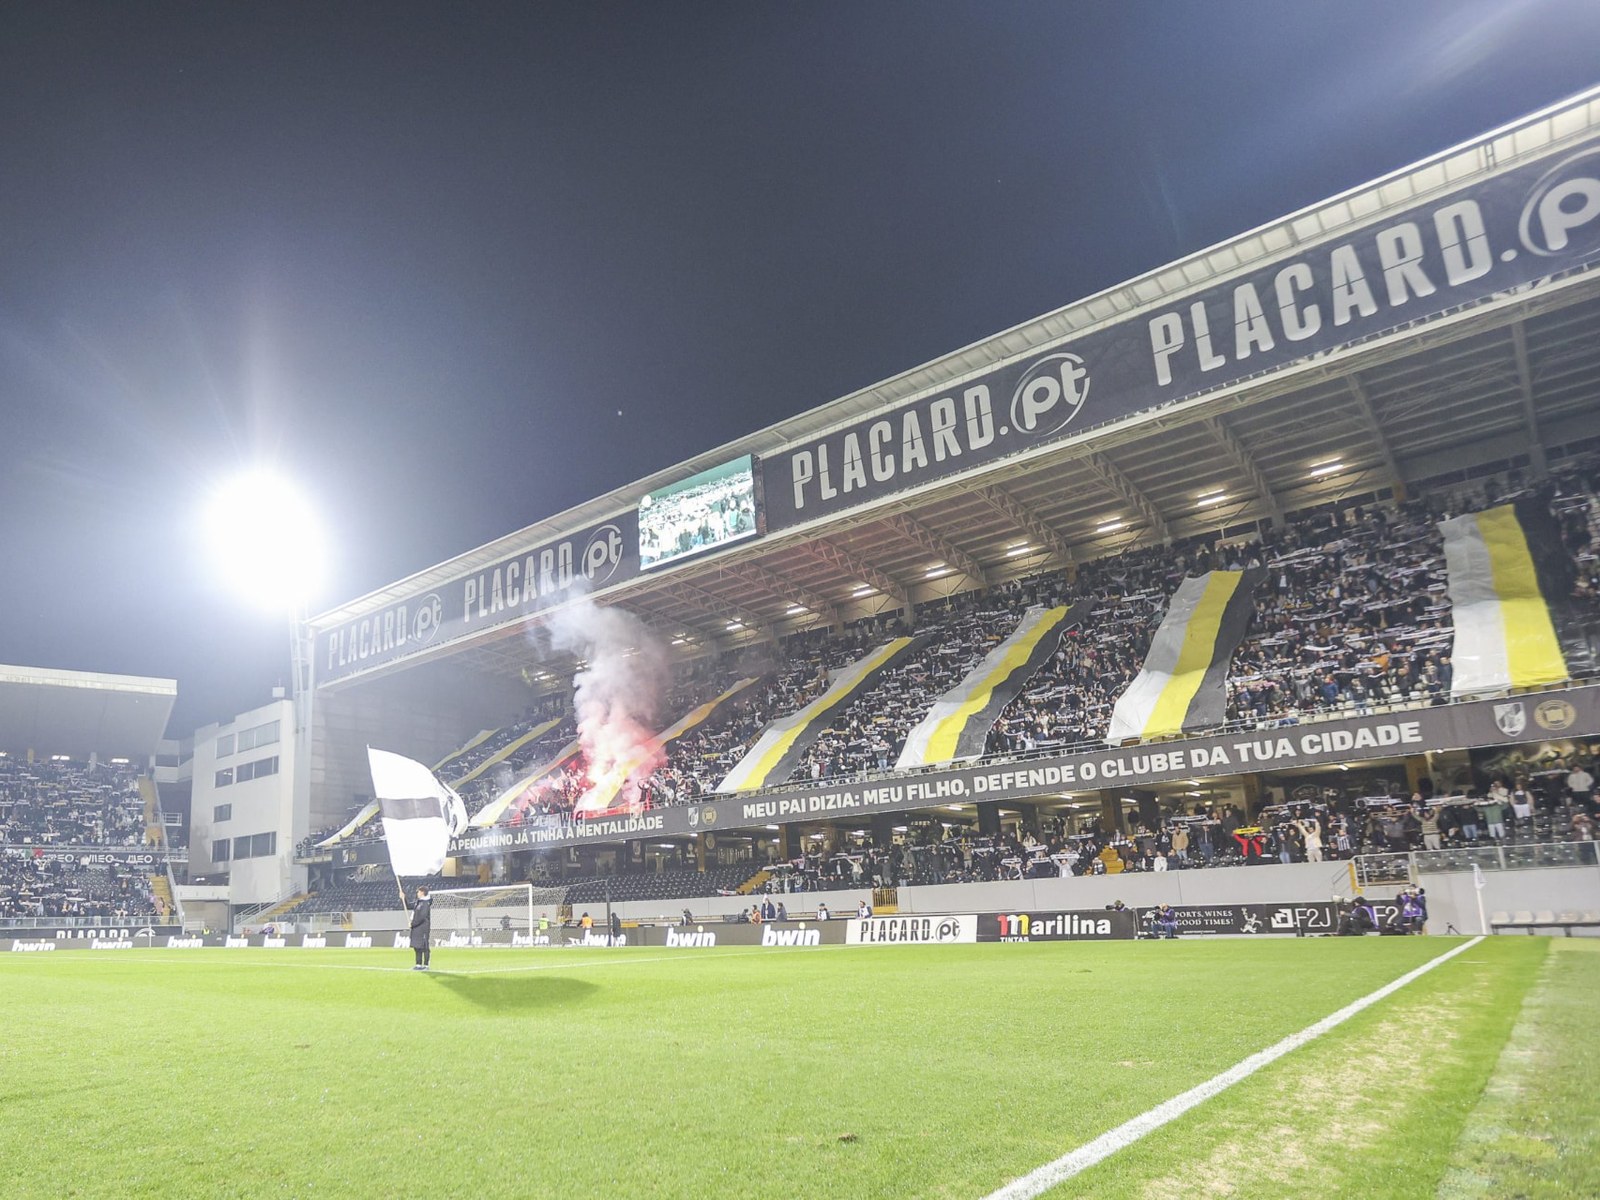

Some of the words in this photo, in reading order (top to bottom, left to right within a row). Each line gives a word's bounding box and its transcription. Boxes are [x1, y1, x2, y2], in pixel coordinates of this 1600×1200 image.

[743, 804, 777, 819] MEU
[779, 798, 806, 815] PAI
[809, 793, 860, 812] DIZIA:
[864, 785, 903, 806] MEU
[907, 778, 970, 801] FILHO,
[974, 765, 1076, 793] DEFENDE
[1082, 762, 1097, 782] O
[1101, 751, 1184, 777] CLUBE
[1191, 748, 1230, 768] DA
[1233, 737, 1297, 763] TUA
[1300, 721, 1424, 755] CIDADE
[458, 834, 513, 850] PEQUENINO
[515, 829, 529, 845] JÁ
[530, 828, 564, 843] TINHA
[576, 815, 664, 838] MENTALIDADE
[1204, 918, 1234, 926] TIMES!
[1205, 909, 1233, 917] WINES
[666, 925, 716, 947] bwin
[762, 922, 820, 946] bwin
[860, 918, 960, 942] PLACARD.pt
